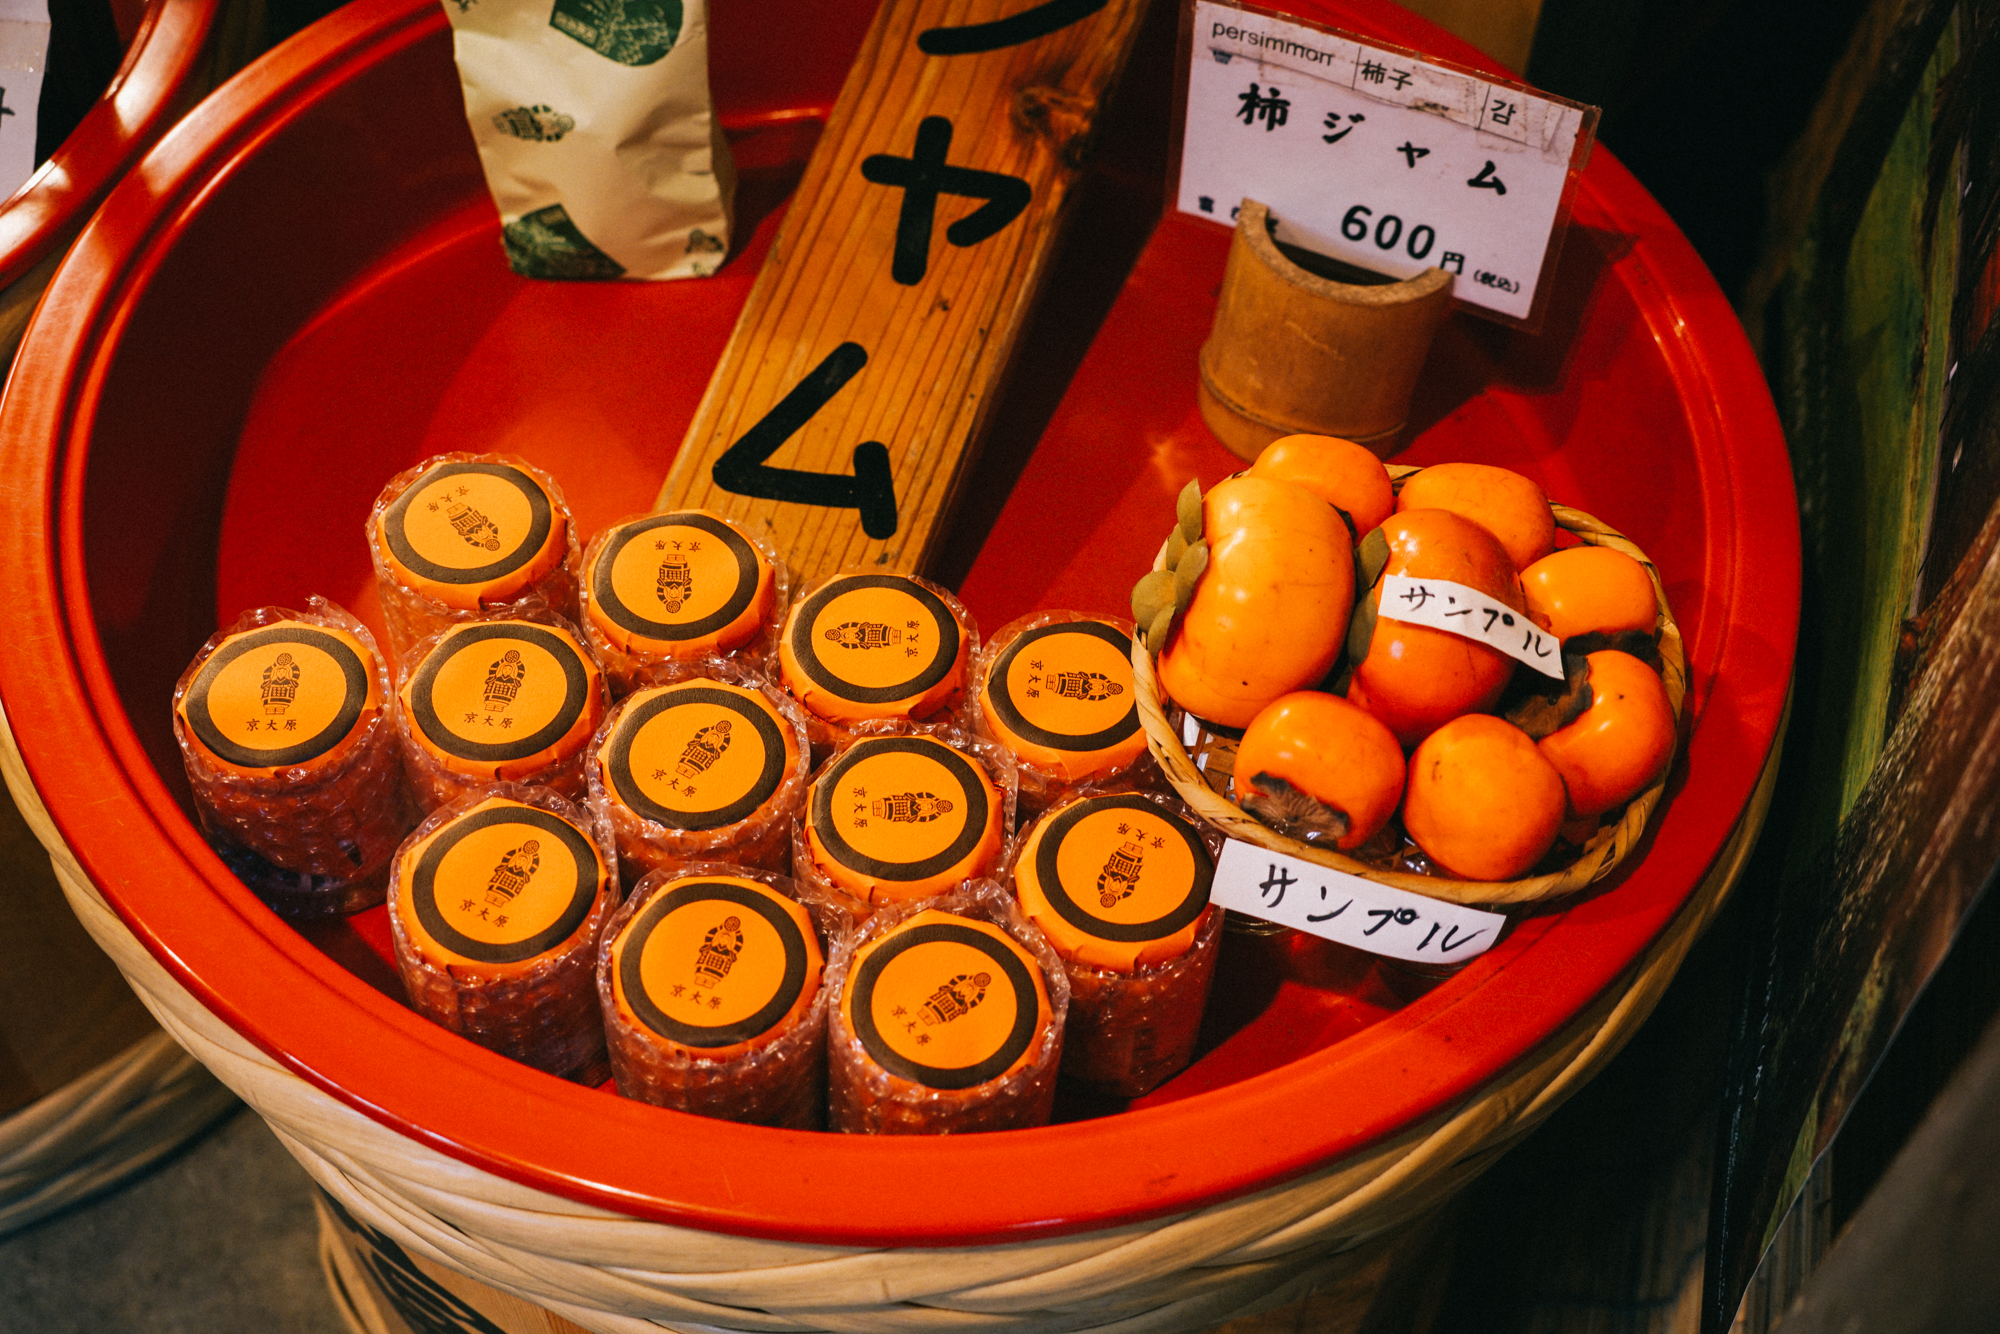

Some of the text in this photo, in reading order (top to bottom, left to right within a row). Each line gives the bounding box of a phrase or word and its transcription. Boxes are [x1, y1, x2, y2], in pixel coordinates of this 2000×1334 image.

[1211, 19, 1334, 67] persimmon
[1360, 59, 1414, 91] 柿子
[1490, 98, 1517, 127] 감
[1236, 82, 1507, 195] 柿ジャム
[426, 484, 470, 513] 京大原
[653, 538, 702, 552] 京大原
[1400, 585, 1553, 659] サンプル
[904, 619, 920, 659] 京大原
[1028, 658, 1044, 699] 京大原
[245, 717, 298, 732] 京大原
[462, 711, 515, 730] 京大原
[651, 768, 697, 799] 京大原
[852, 786, 868, 829] 京大原
[1115, 821, 1166, 850] 京大原
[458, 898, 508, 929] 京大原
[1259, 863, 1491, 953] サンプル
[669, 982, 722, 1010] 京大原
[890, 1004, 934, 1047] 京大原
